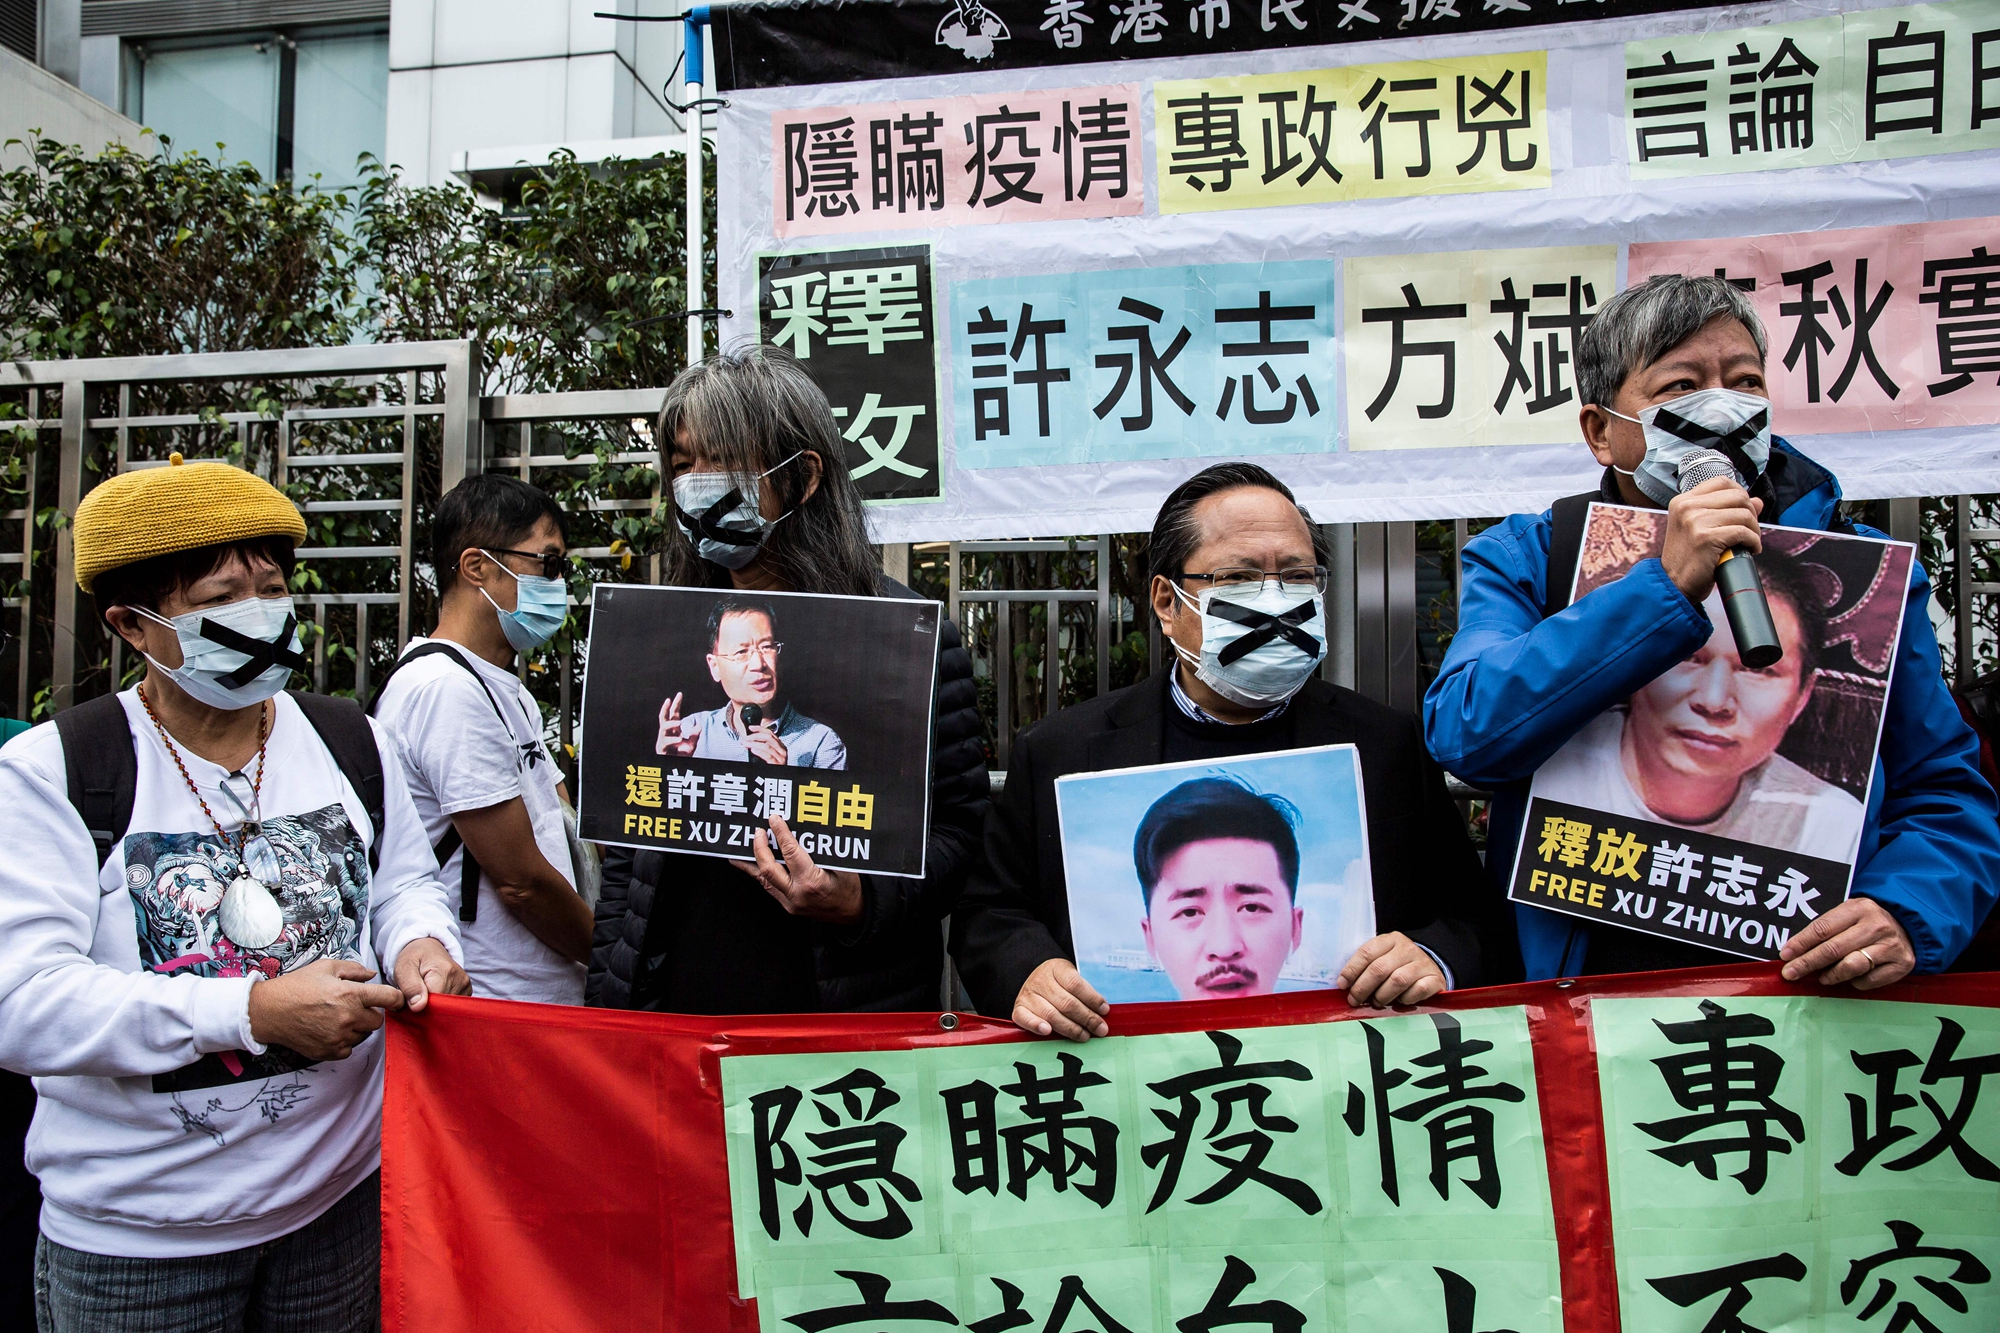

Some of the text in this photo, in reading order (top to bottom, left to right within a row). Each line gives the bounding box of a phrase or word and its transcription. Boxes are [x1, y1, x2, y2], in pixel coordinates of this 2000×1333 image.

[785, 99, 1131, 222] 隱瞞疫情
[1168, 69, 1538, 193] 專政行兇
[968, 290, 1320, 441] 許永志
[1362, 276, 1597, 423] 方斌
[623, 814, 682, 840] FREE
[688, 820, 721, 843] XU
[625, 764, 874, 831] 還許章潤自由
[1529, 869, 1790, 951] FREE XU ZHIYON
[1537, 816, 1822, 920] 釋放許志永
[749, 1013, 1526, 1241] 隱瞞疫情
